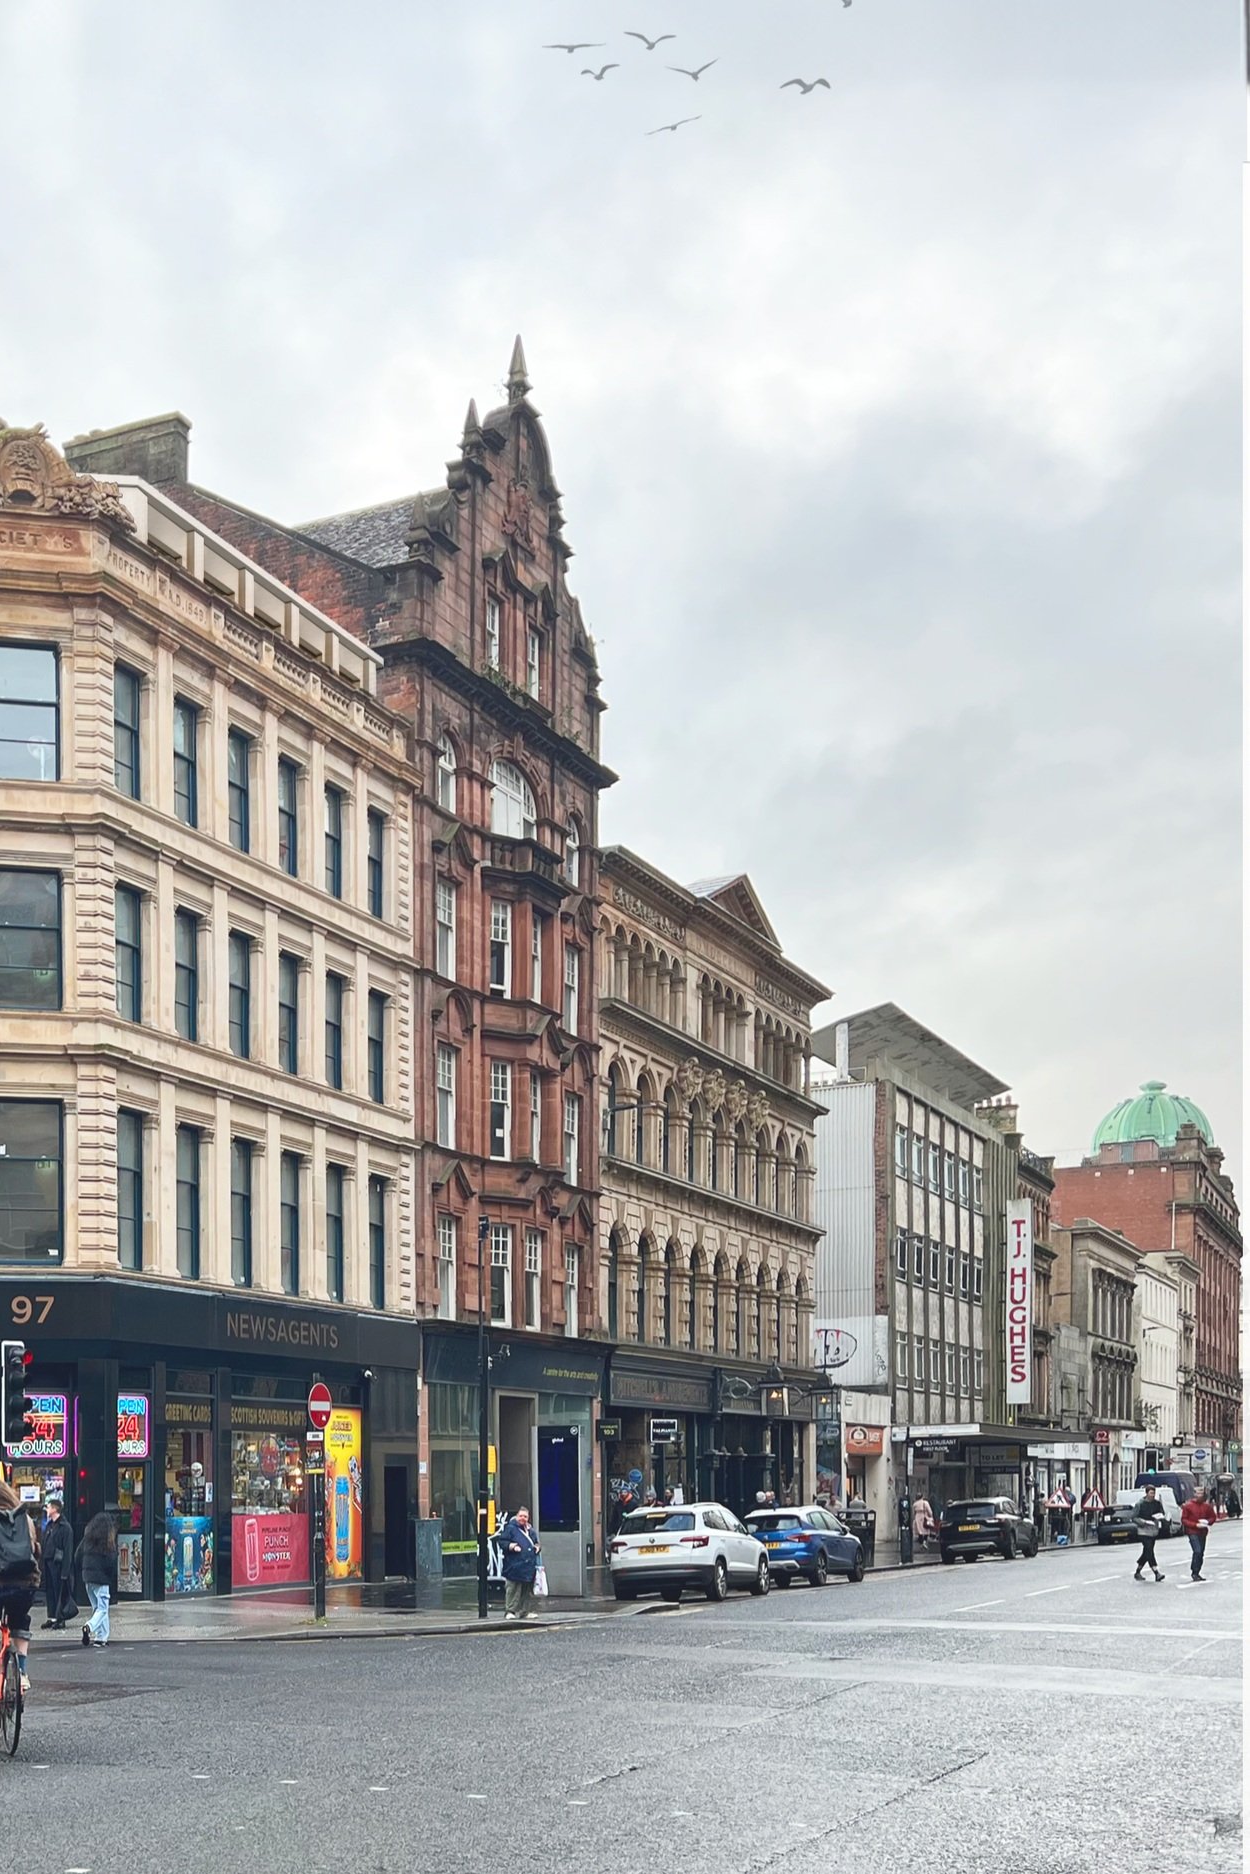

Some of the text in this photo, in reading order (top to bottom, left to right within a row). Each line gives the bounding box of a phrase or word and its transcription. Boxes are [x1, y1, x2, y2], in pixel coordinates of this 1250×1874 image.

[107, 551, 151, 587] PROPERTY
[10, 1295, 55, 1324] 97
[226, 1311, 339, 1349] NEWSAGENTS
[1008, 1267, 1027, 1384] HUGHES
[32, 1398, 63, 1413] PEN
[118, 1399, 146, 1415] PEN
[165, 1403, 211, 1423] GREETING CARDS
[231, 1406, 258, 1424] SCOTTISH
[258, 1408, 288, 1426] SOUVENIRS
[118, 1415, 140, 1440] 24
[118, 1441, 146, 1454] OURS
[264, 1535, 290, 1548] PUNCH
